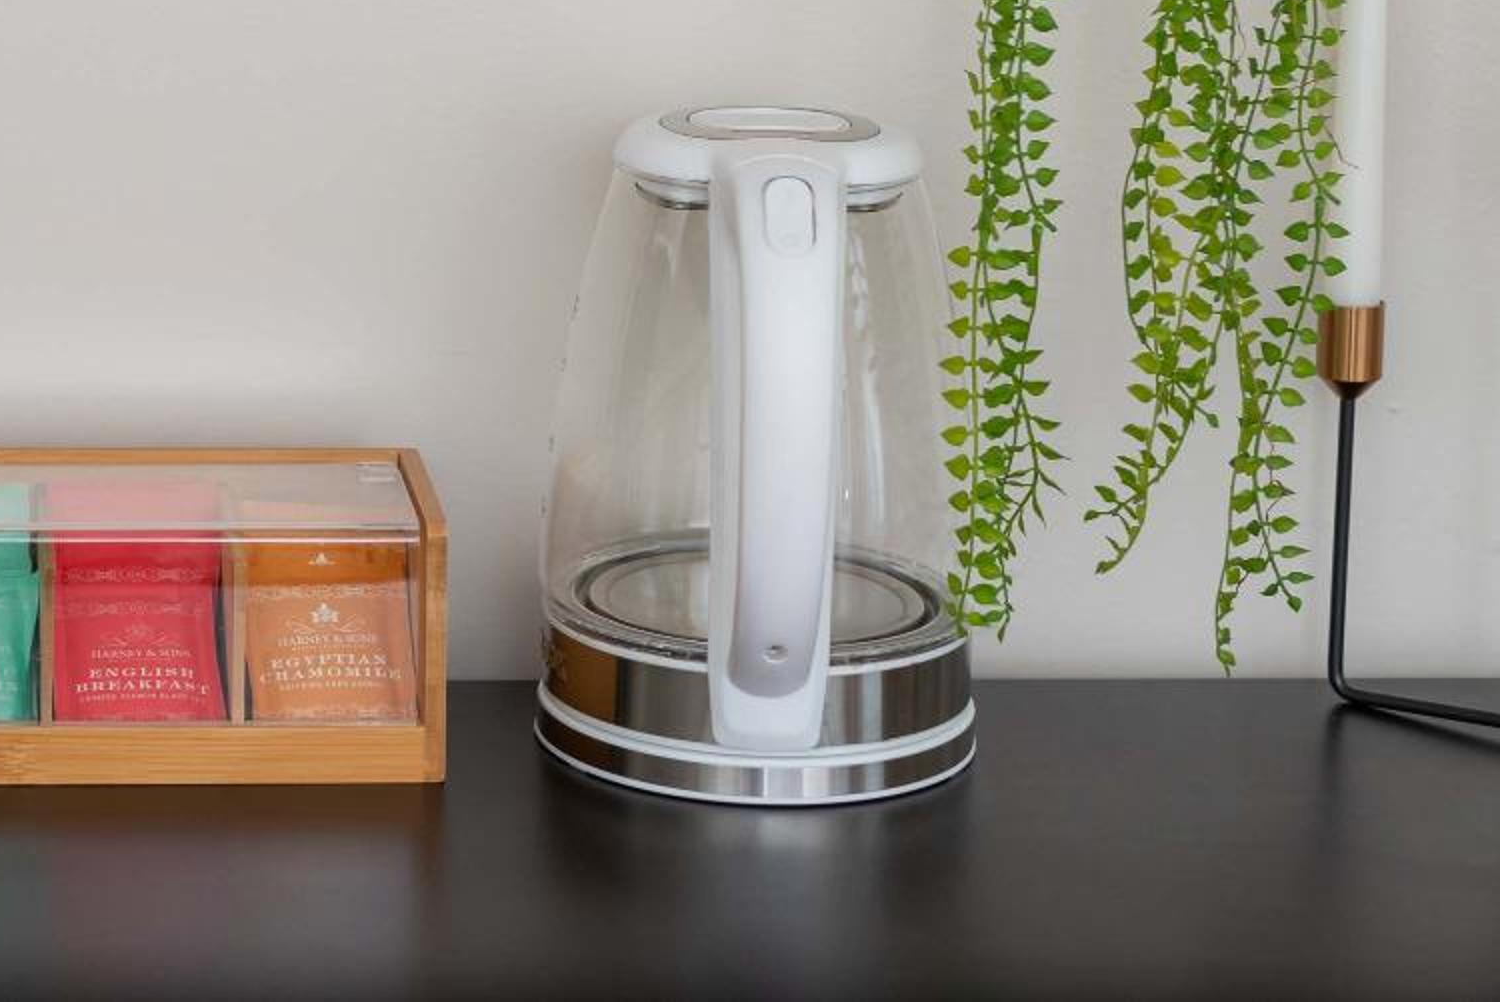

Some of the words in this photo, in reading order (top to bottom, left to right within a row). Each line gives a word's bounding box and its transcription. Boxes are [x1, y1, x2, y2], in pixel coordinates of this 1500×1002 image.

[270, 653, 387, 670] EGYPTIAN
[88, 666, 194, 679] ENGLISH
[260, 666, 401, 685] CHAMOMILE
[75, 679, 210, 696] BREAKFAST
